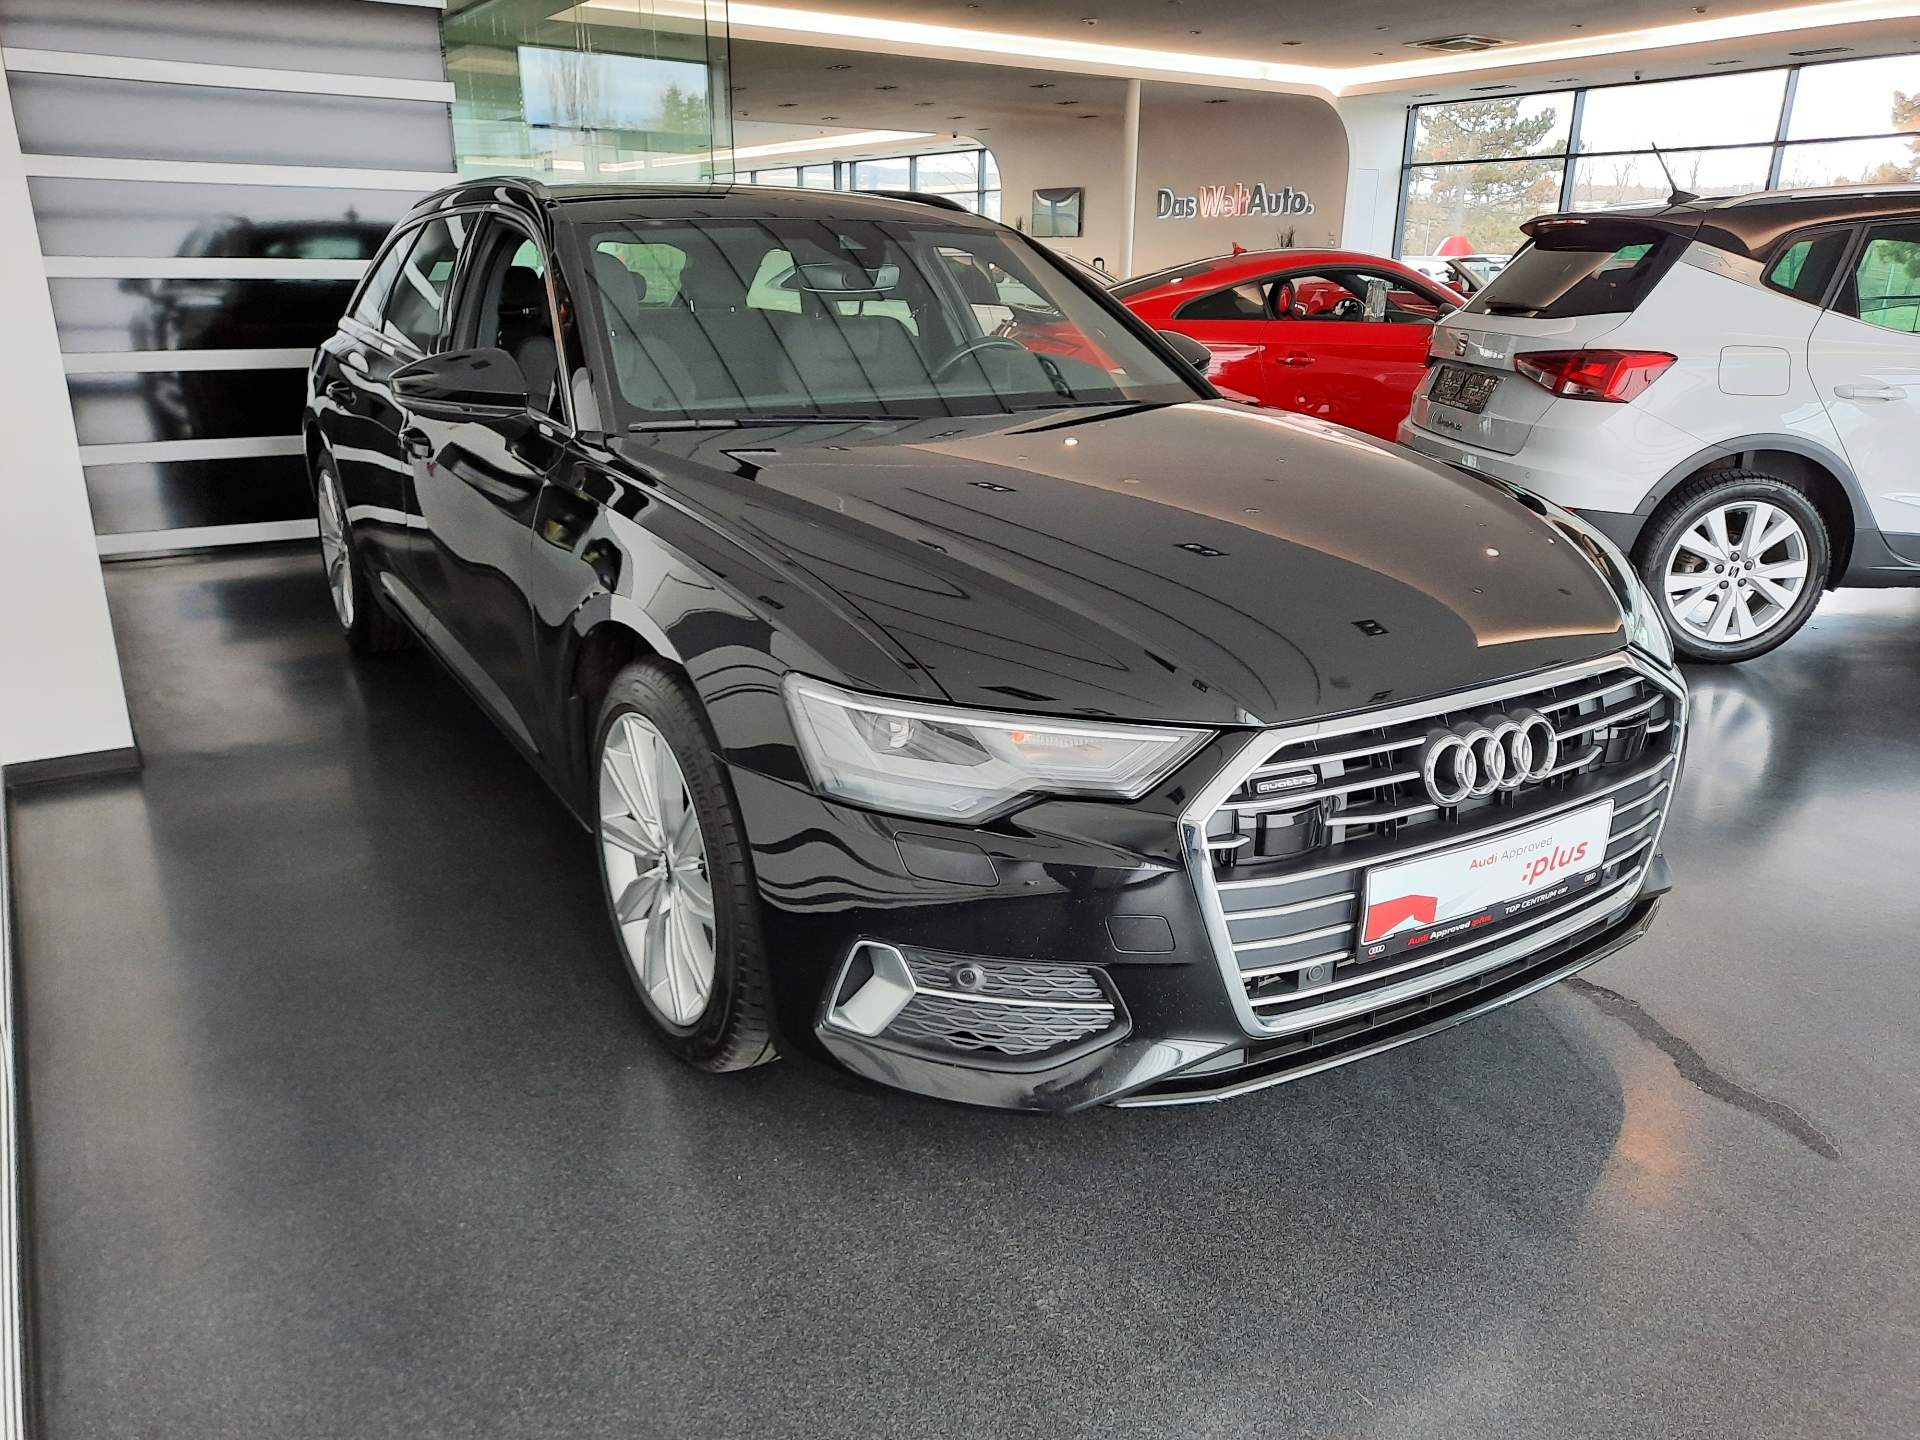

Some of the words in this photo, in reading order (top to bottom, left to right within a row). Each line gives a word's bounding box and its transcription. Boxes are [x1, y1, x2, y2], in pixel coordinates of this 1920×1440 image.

[1157, 188, 1197, 219] Das
[1260, 776, 1316, 792] quattro
[1469, 852, 1498, 871] Audi
[1500, 835, 1554, 862] Approved
[1505, 903, 1521, 915] TOP
[1521, 890, 1557, 909] CENTRUM
[1407, 932, 1429, 946] Audi
[1429, 921, 1471, 940] Approved
